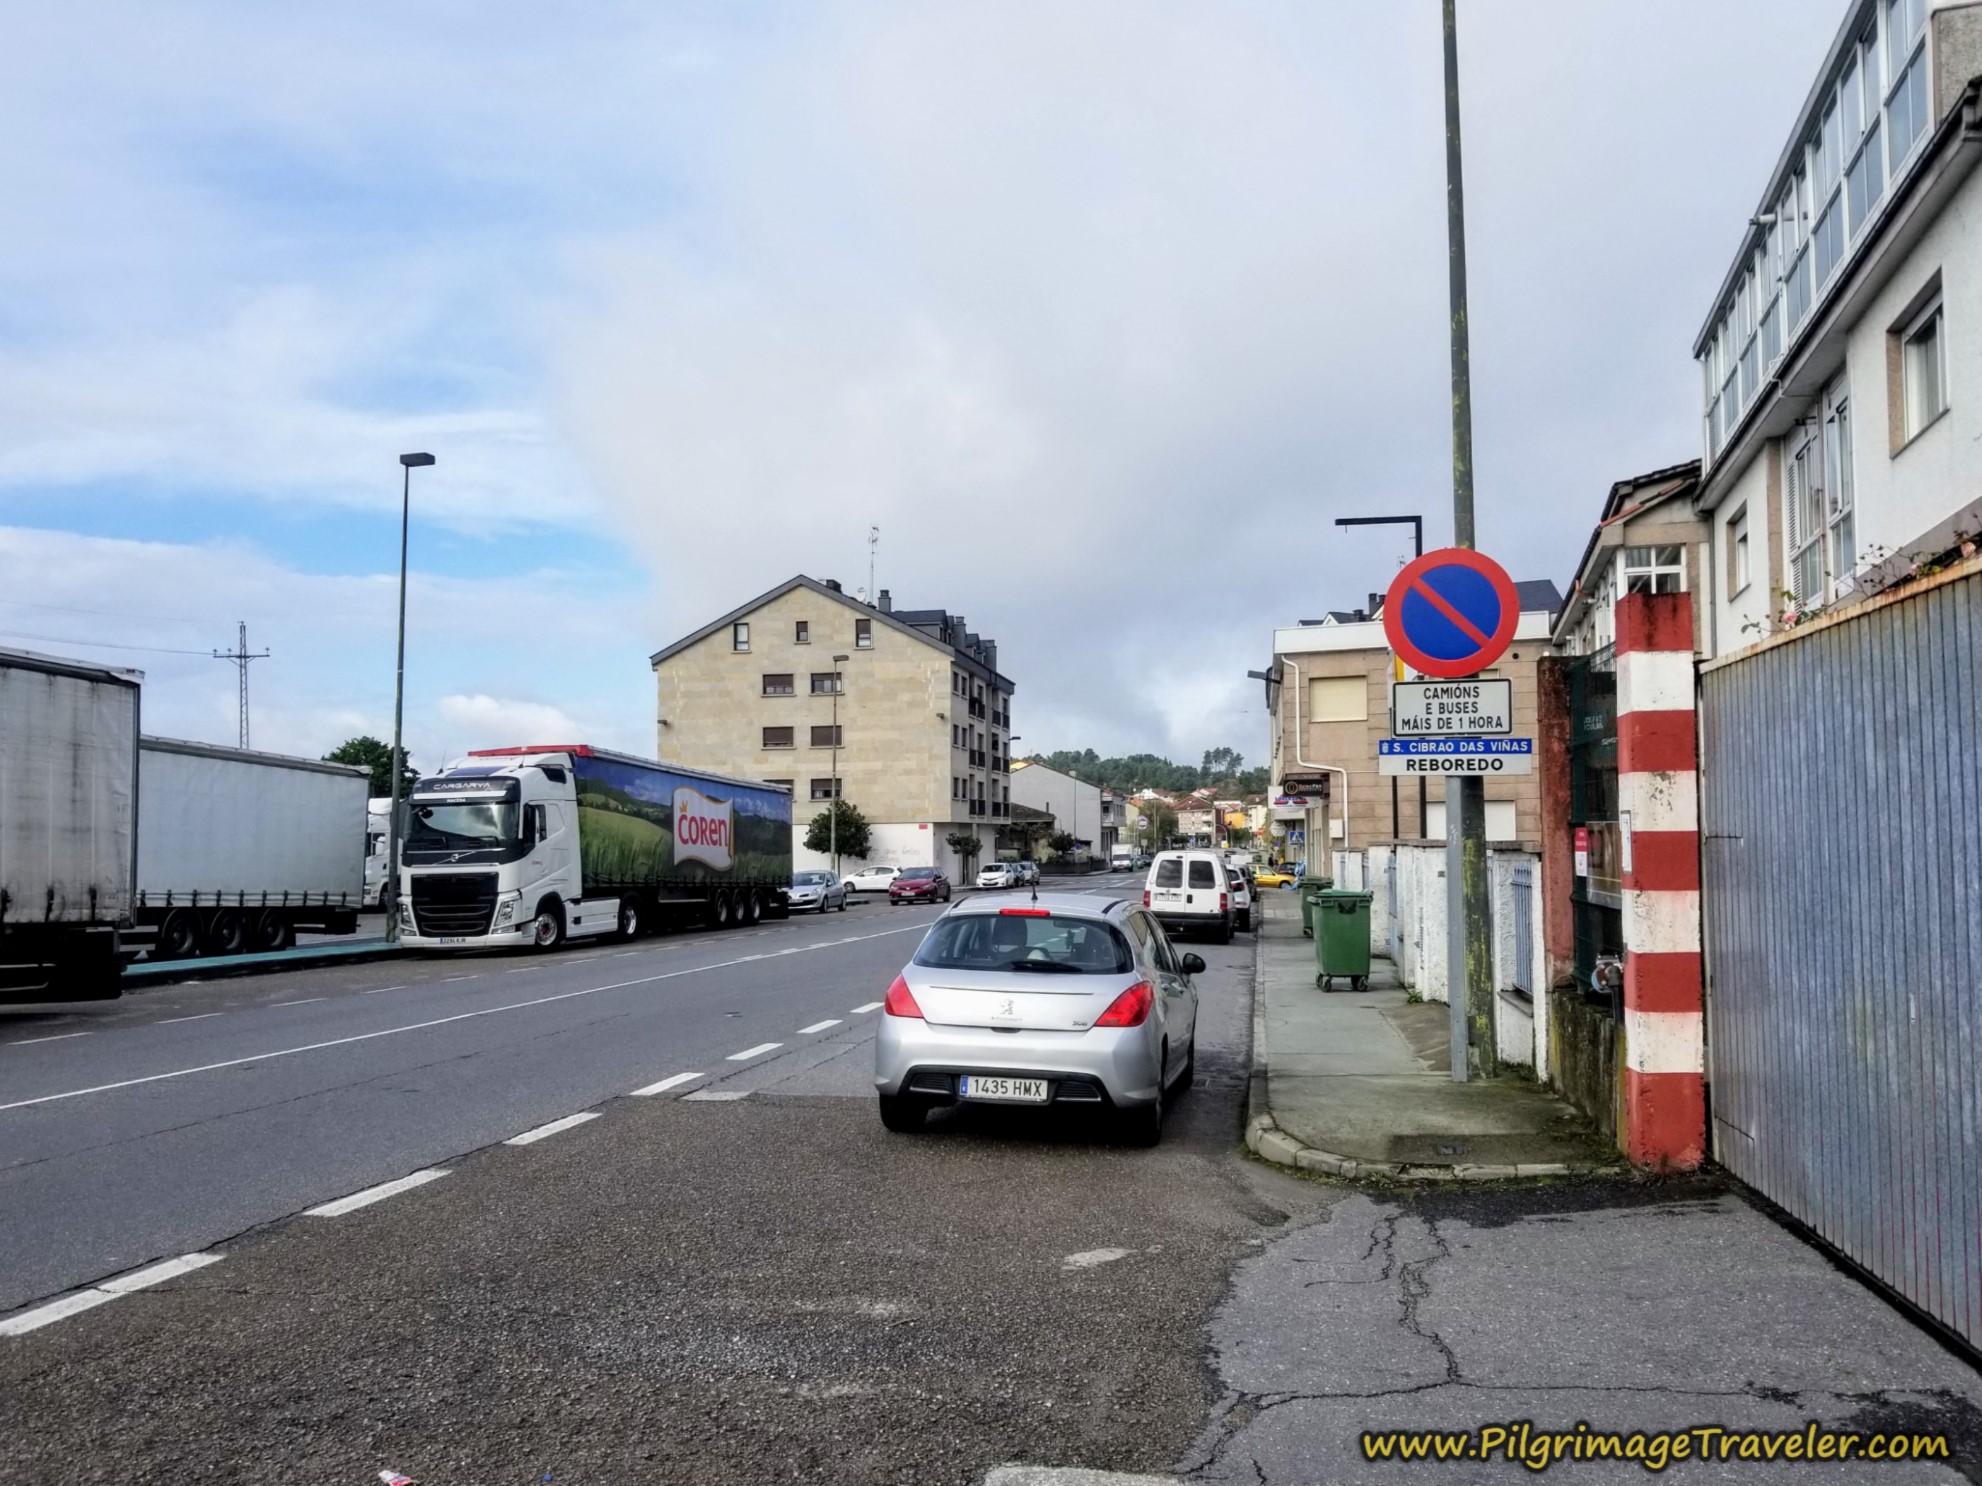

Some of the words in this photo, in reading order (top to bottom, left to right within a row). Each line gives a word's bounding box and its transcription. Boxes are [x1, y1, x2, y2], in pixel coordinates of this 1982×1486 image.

[1423, 683, 1480, 700] CAMIÓNS
[1425, 702, 1433, 715] E
[1438, 701, 1479, 715] BUSES
[1401, 715, 1432, 731] MÁIS
[1437, 717, 1453, 730] DE
[1458, 717, 1463, 729] 1
[1468, 716, 1503, 729] HORA
[1393, 743, 1404, 752] S.
[1409, 742, 1454, 752] CIBRAO
[1460, 741, 1484, 752] DAS
[1490, 740, 1528, 751] VIÑAS
[1406, 758, 1503, 771] REBOREDO
[974, 1078, 1008, 1094] 1435
[1013, 1080, 1042, 1097] HMX
